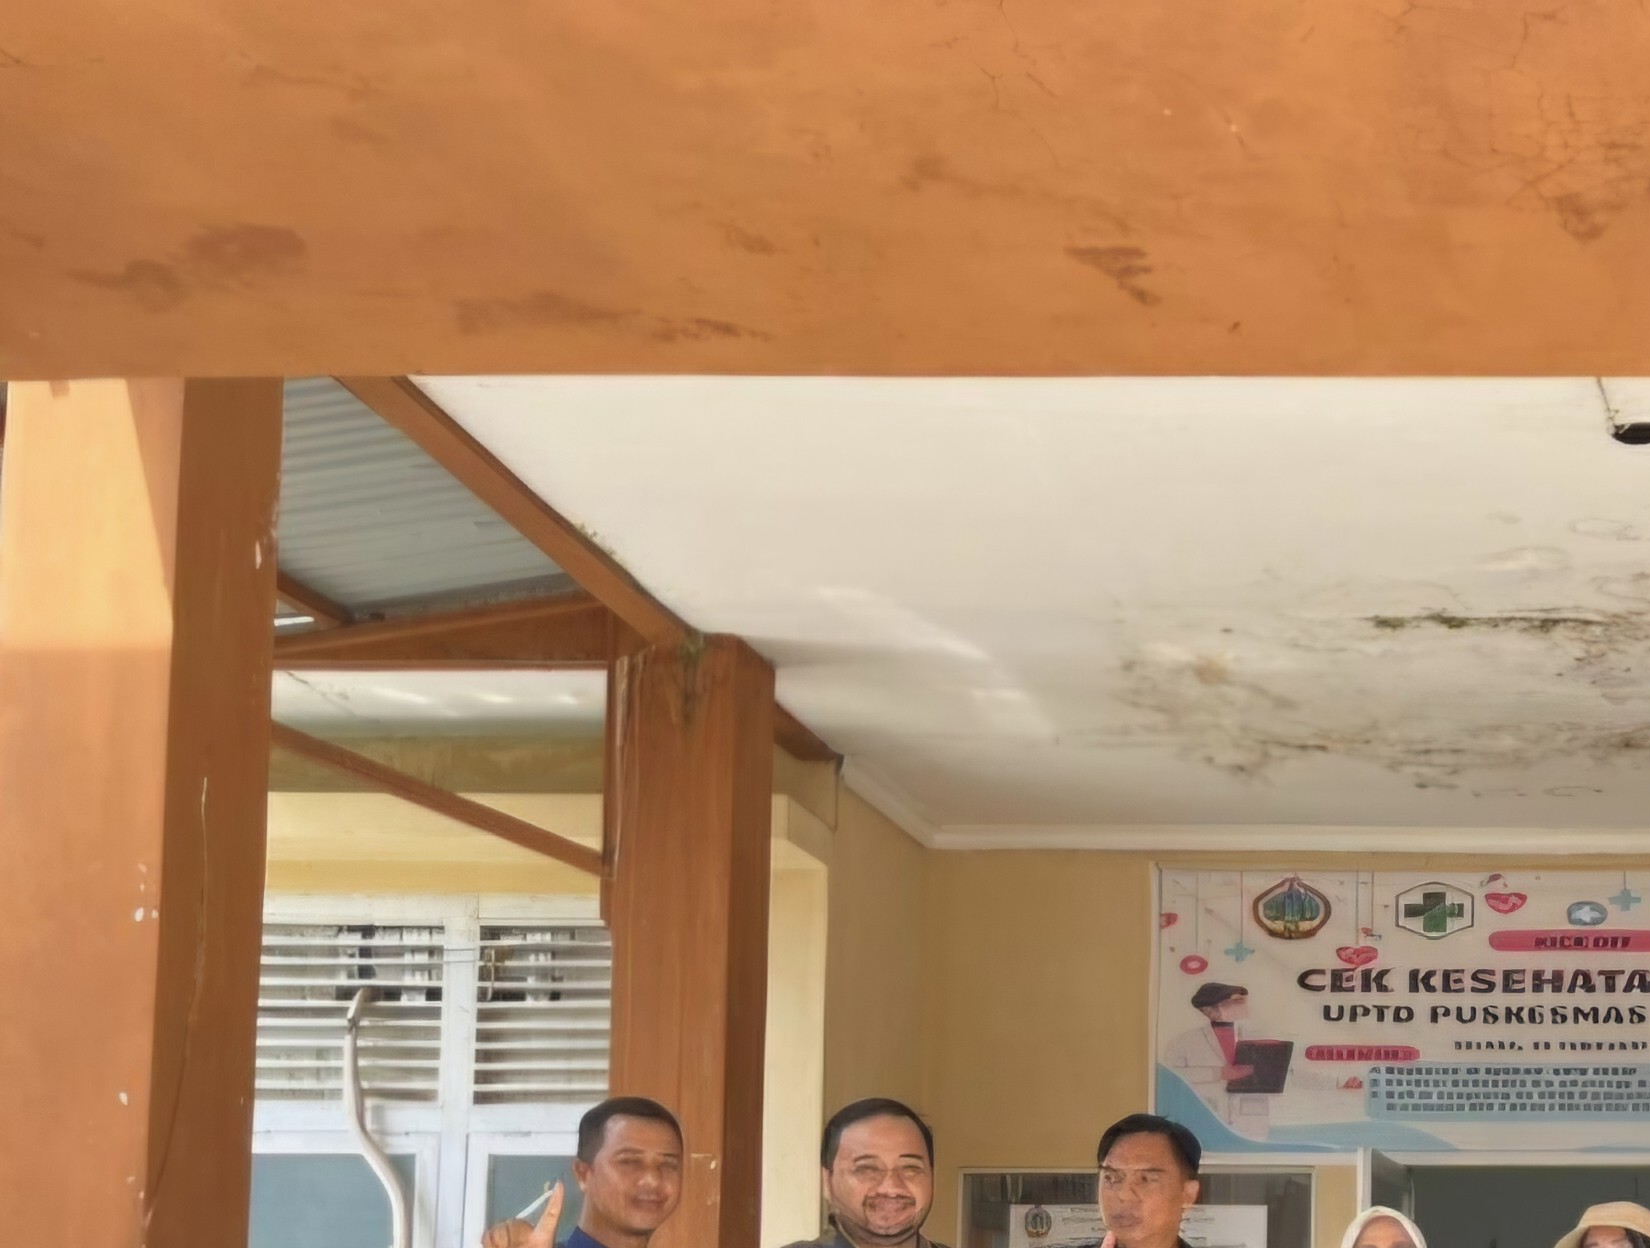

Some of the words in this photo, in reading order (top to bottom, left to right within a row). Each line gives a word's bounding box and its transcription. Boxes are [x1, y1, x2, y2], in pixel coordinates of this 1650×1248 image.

[1296, 967, 1396, 993] CEK
[1322, 1004, 1415, 1024] UPTD
[1429, 1004, 1647, 1025] PUSKESMAS
